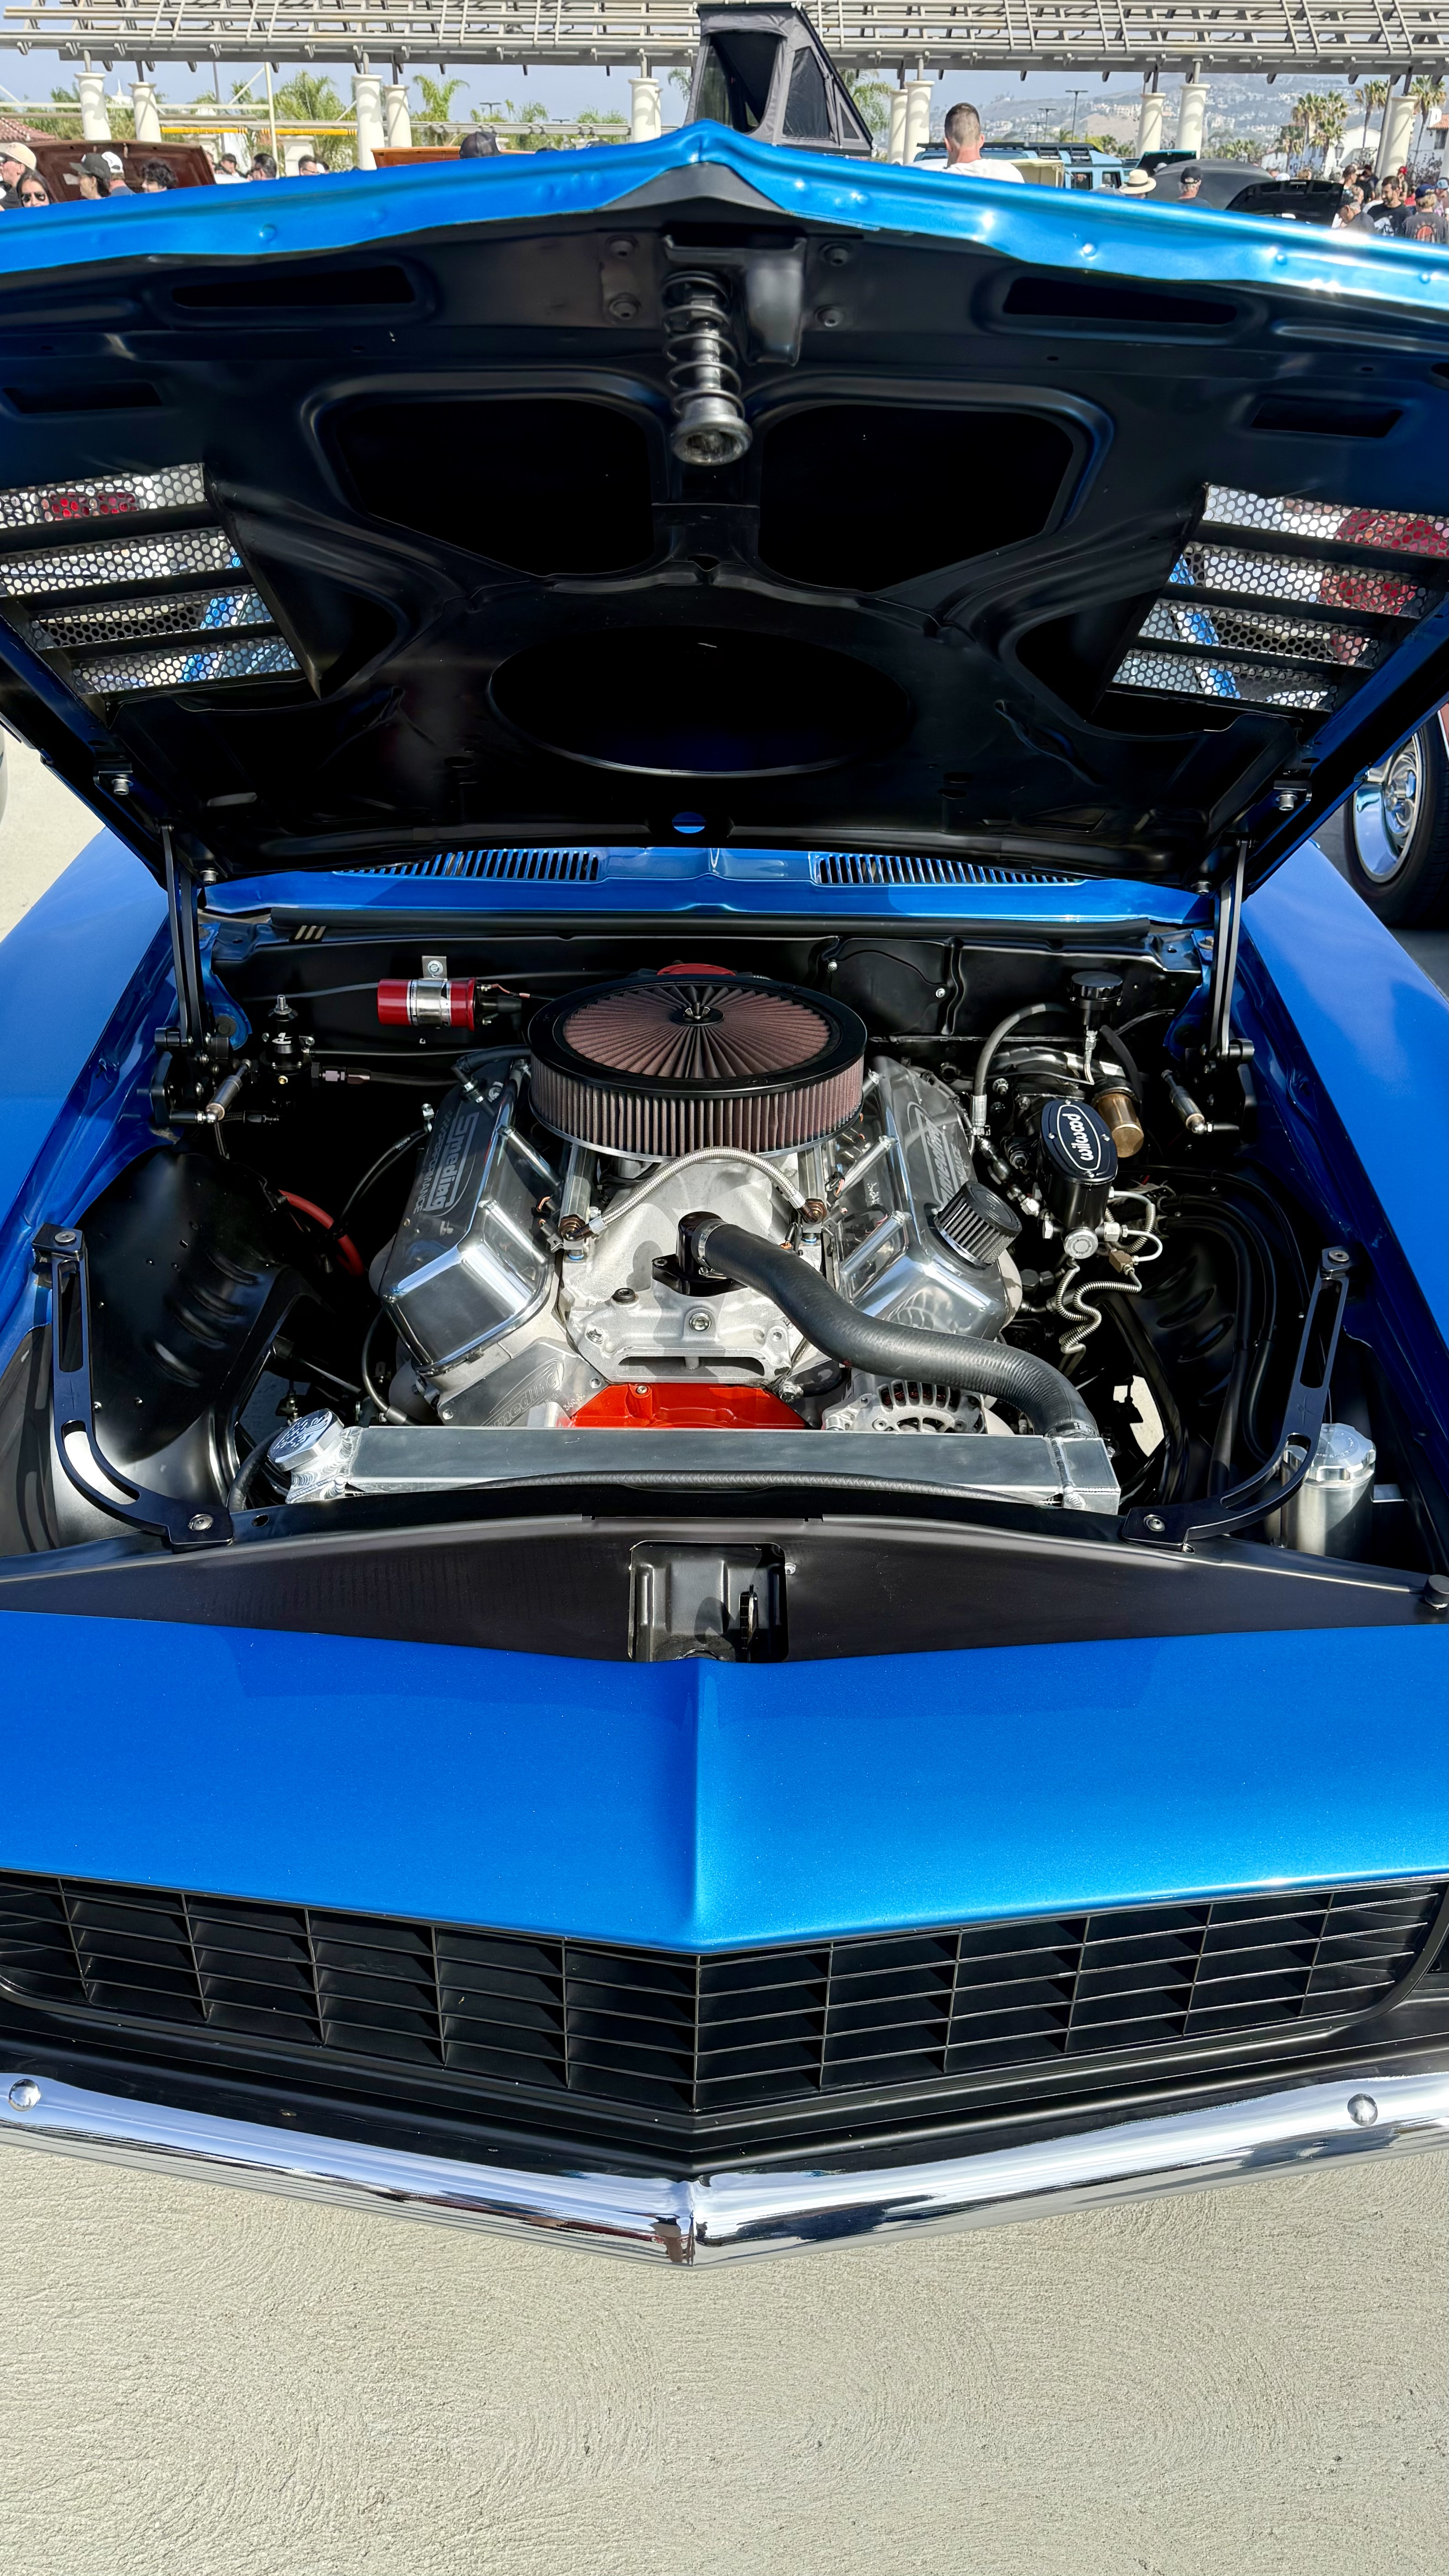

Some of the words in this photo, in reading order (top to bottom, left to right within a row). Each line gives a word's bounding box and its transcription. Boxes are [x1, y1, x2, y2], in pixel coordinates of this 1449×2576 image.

[413, 1131, 447, 1215] PERFORMANCE
[423, 1112, 479, 1212] Smeding
[1062, 1114, 1094, 1161] wilwood
[483, 1362, 560, 1426] meding
